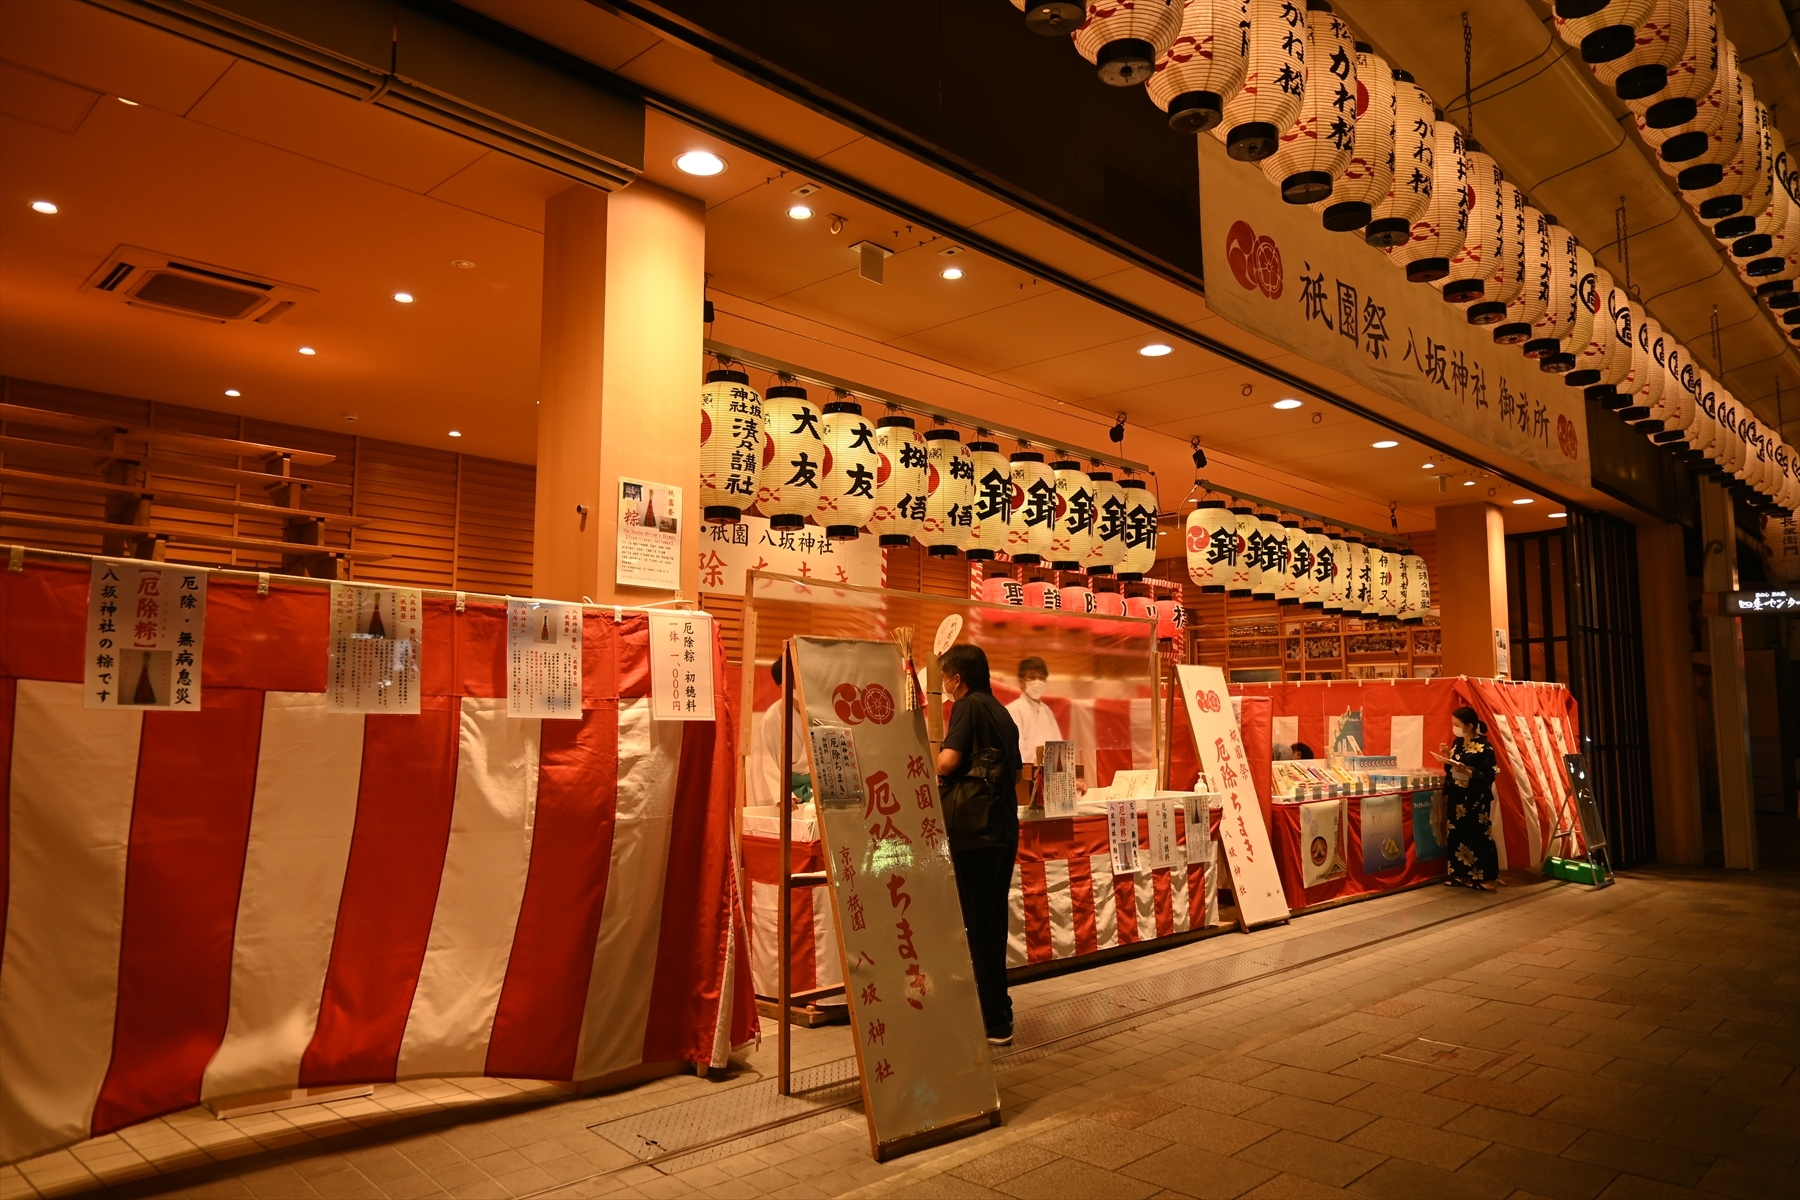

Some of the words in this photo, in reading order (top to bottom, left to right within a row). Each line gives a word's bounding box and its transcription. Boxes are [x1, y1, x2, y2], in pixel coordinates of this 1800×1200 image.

[1299, 261, 1390, 360] 祇園祭
[1402, 327, 1489, 409] 八坂神社
[1498, 376, 1550, 448] 御旅所
[784, 407, 821, 489] 大友
[844, 422, 876, 499] 大友
[975, 467, 1012, 525] 錦
[1022, 477, 1057, 530] 錦
[1065, 487, 1094, 538] 錦
[1098, 495, 1127, 543] 錦
[759, 529, 834, 555] 八坂神社
[1125, 504, 1158, 550] 錦
[1206, 526, 1238, 566] 錦
[1262, 534, 1288, 575] 錦
[96, 568, 120, 702] 八坂神社の粽です
[174, 576, 199, 704] 厄除・無病息災
[669, 623, 679, 642] 一体
[683, 622, 695, 663] 厄除粽
[685, 671, 697, 712] 初穂料
[830, 738, 845, 796] 厄除ちまき
[1230, 729, 1250, 781] 祇園祭
[907, 755, 944, 848] 祇園祭
[1214, 737, 1254, 863] 厄除ちまき
[1224, 830, 1247, 896] 八坂神社
[855, 950, 895, 1083] 八坂神社
